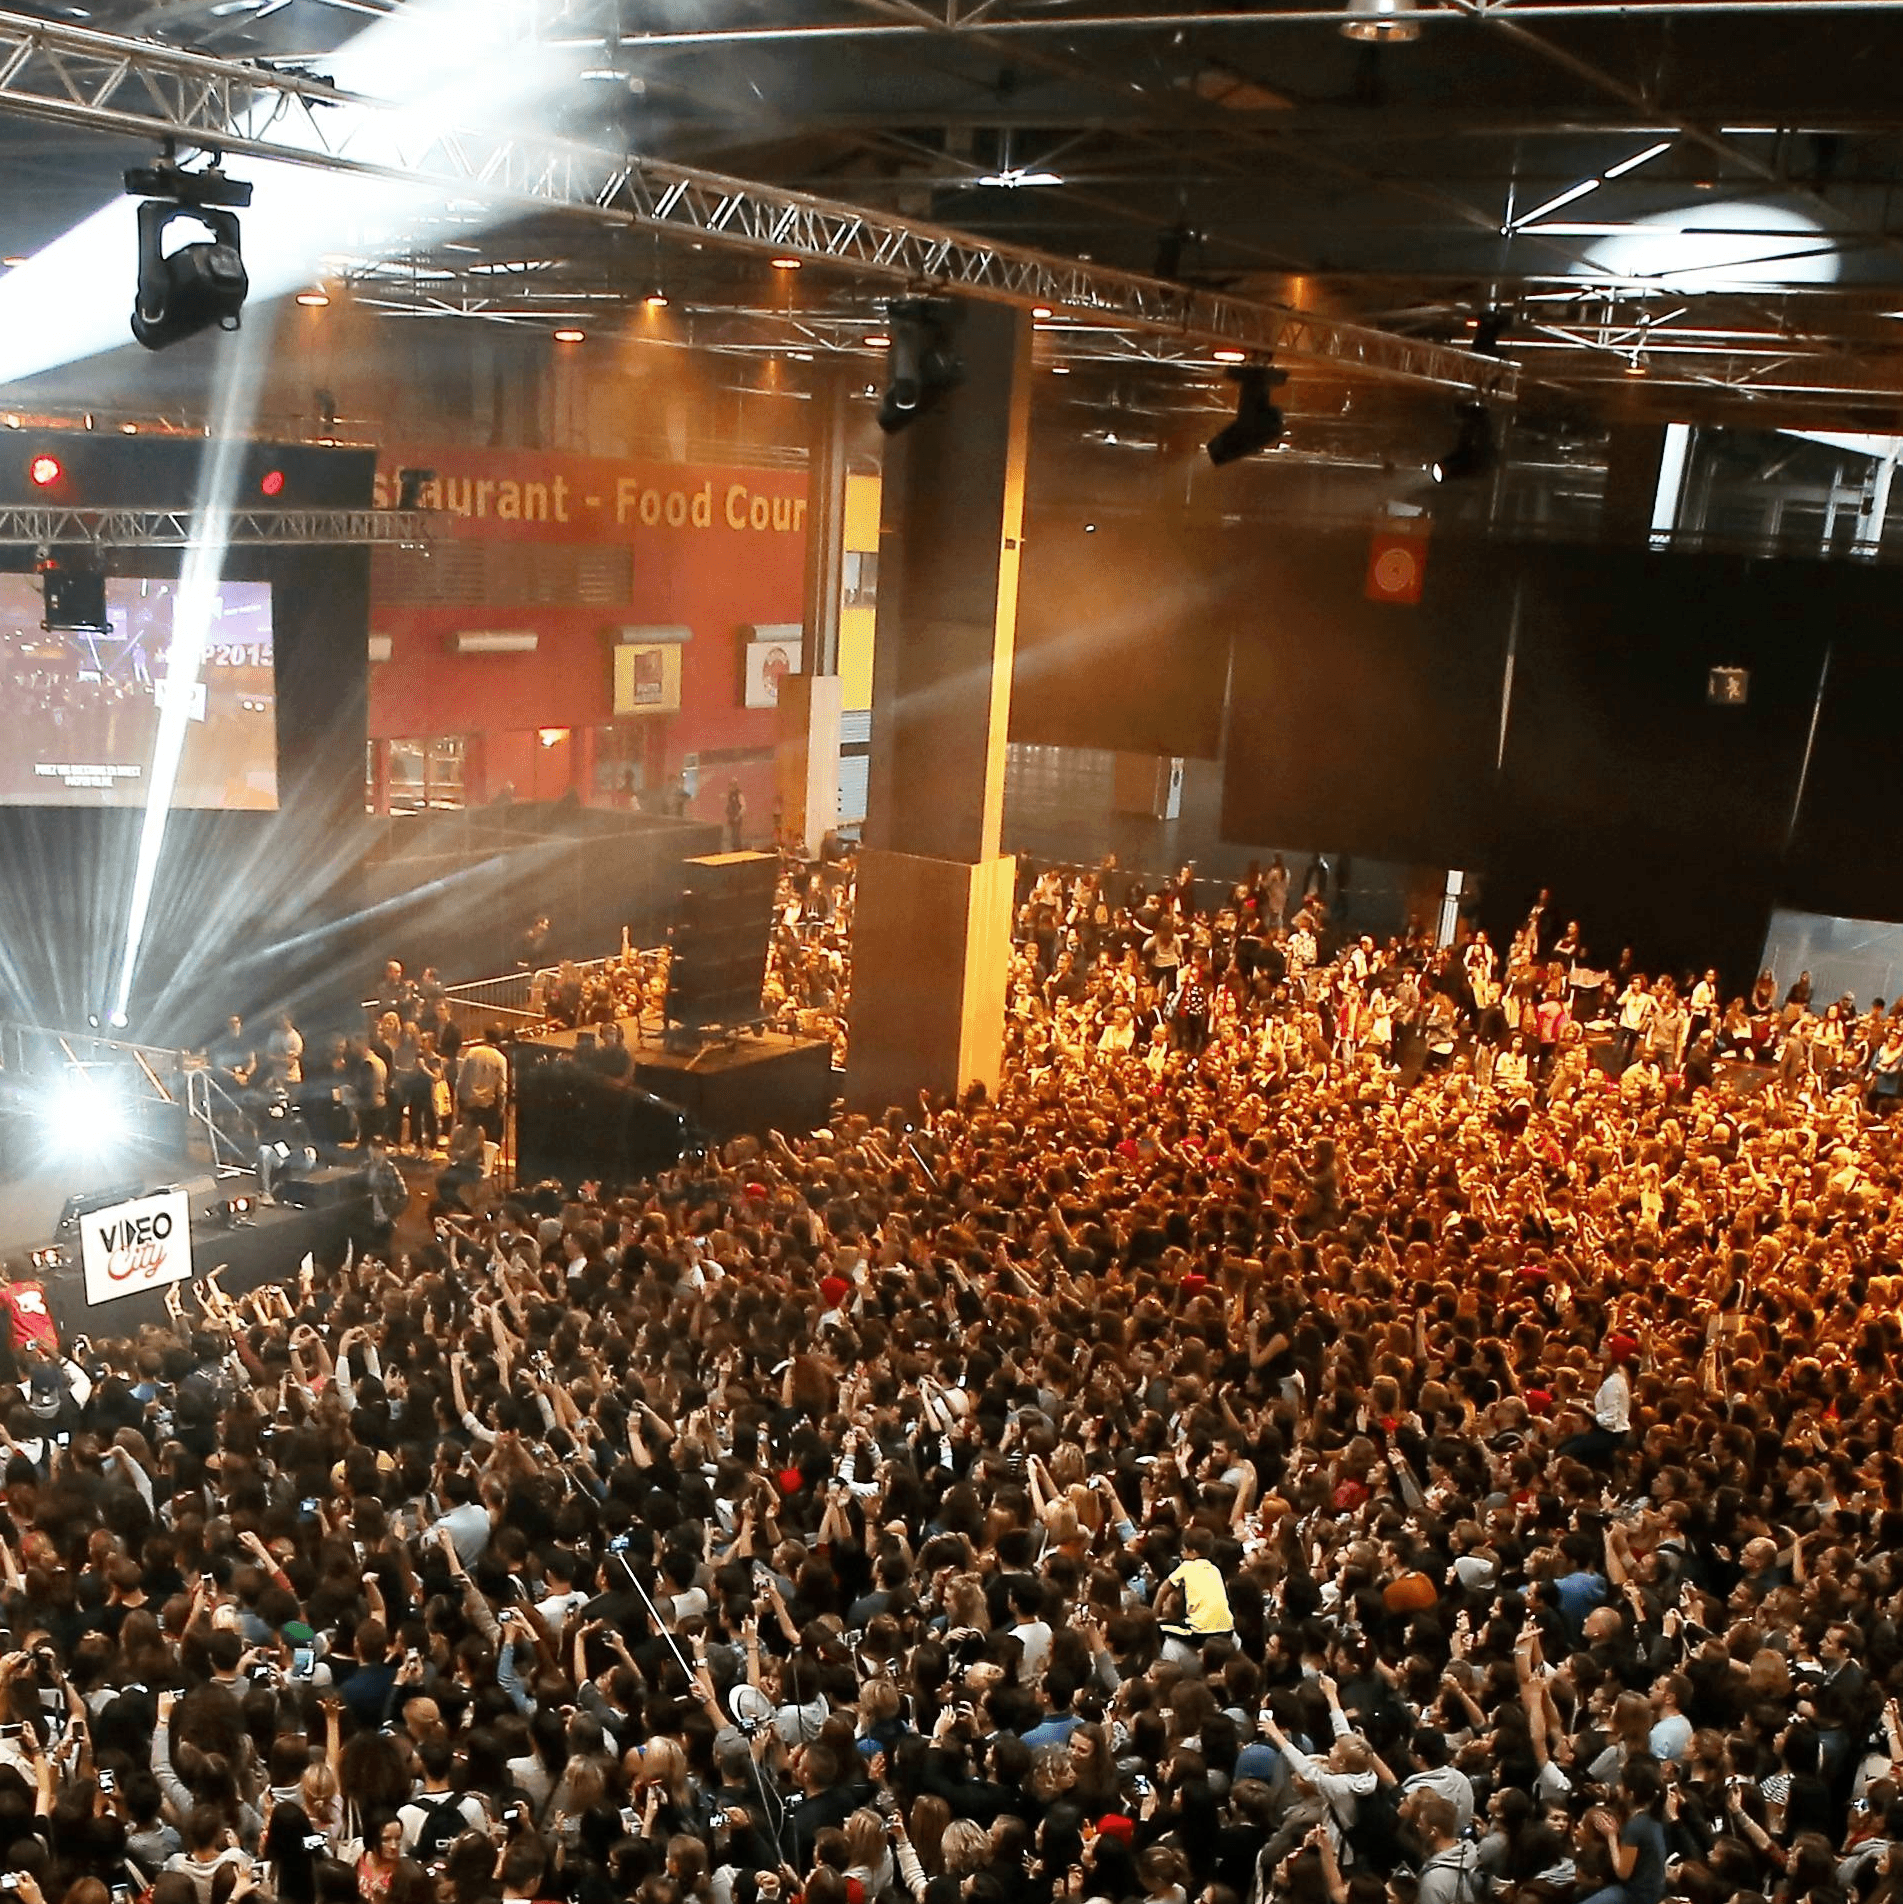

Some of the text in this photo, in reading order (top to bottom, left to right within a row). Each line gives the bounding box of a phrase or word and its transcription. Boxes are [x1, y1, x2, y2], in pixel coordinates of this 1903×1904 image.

[616, 477, 713, 531] Food
[99, 1212, 172, 1254] VIDEO
[107, 1243, 168, 1281] City
